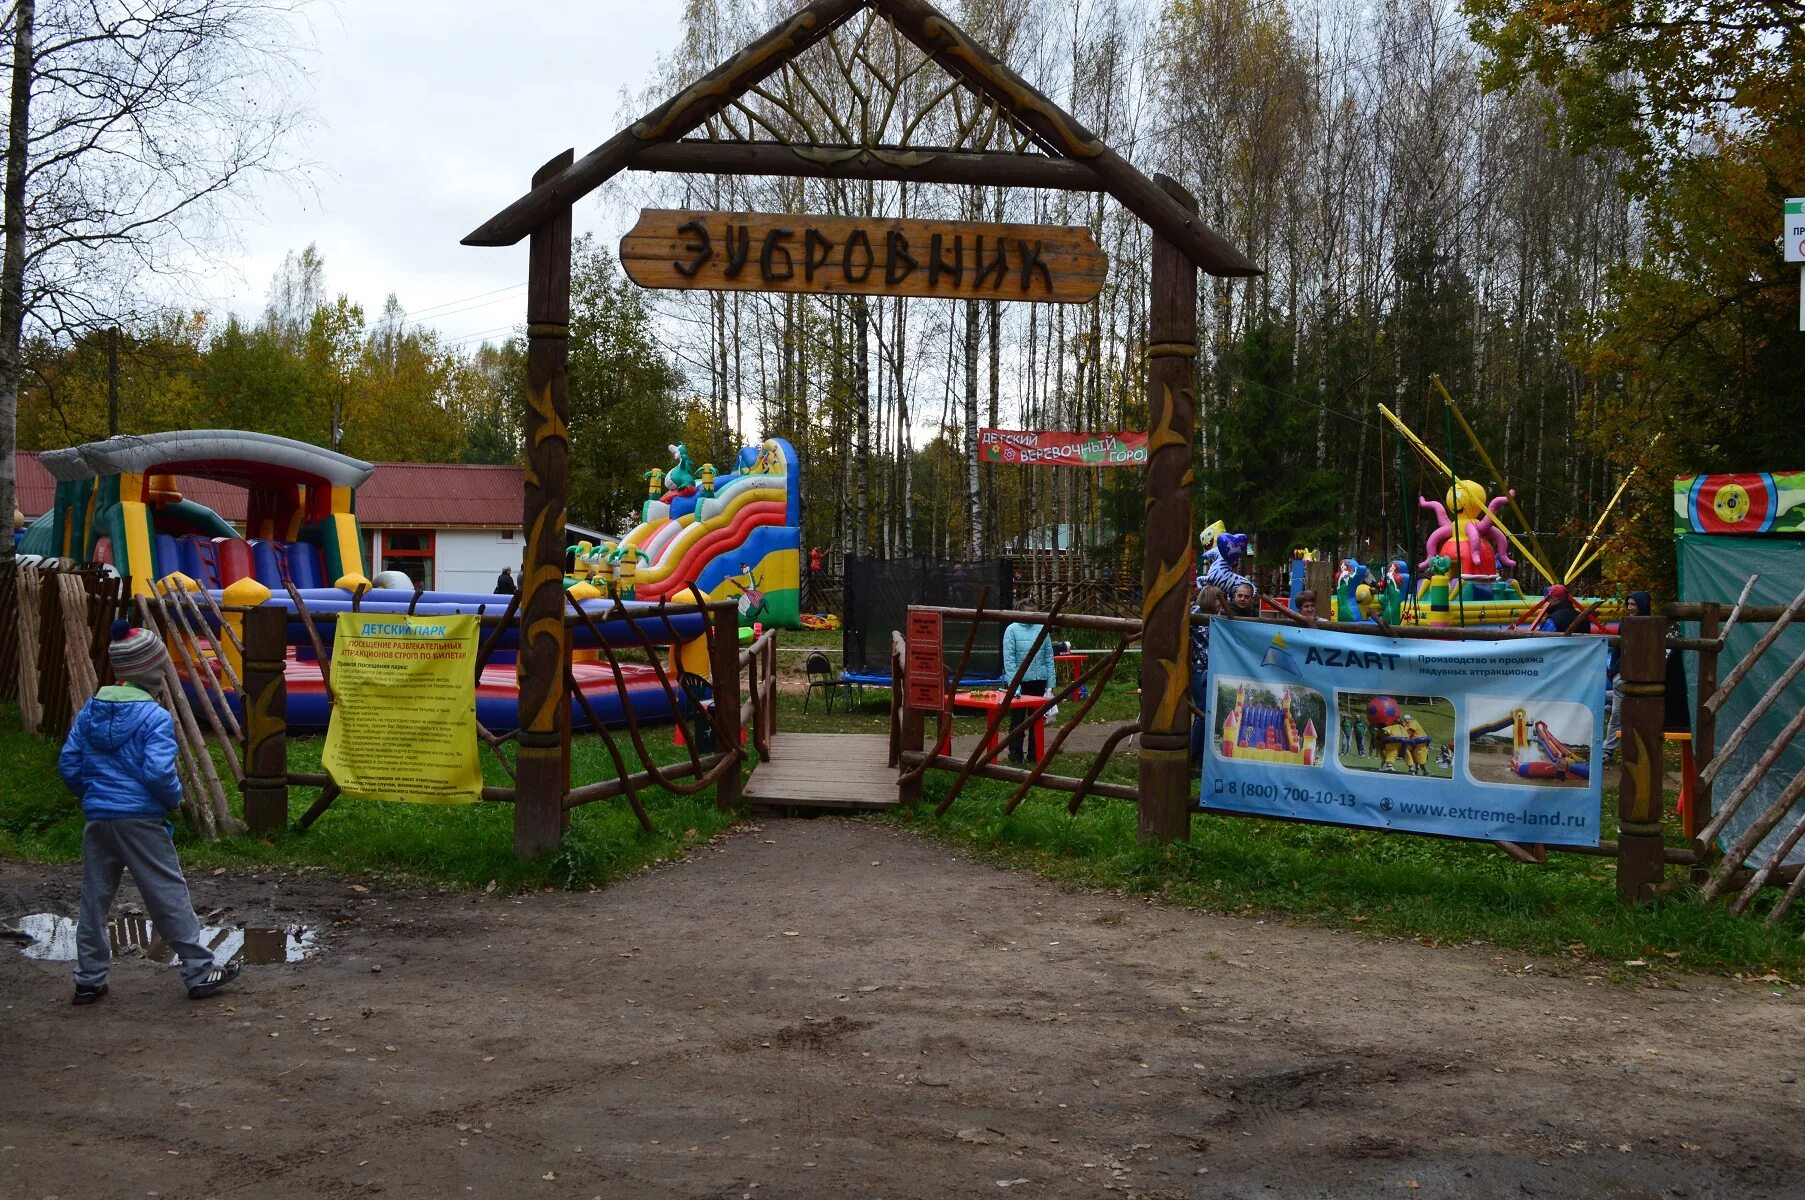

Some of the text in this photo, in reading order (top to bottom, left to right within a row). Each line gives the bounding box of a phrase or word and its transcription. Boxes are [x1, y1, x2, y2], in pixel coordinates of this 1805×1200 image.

[673, 220, 1054, 293] ЗУБРОВНИК
[981, 432, 1039, 446] ДЕТСКИЙ
[1020, 435, 1117, 462] ВЕРЕВОЧНЫЙ
[361, 622, 446, 636] ДЕТСКИЙ ПАРК
[348, 641, 392, 649] ПОСЕЩЕНИЕ
[341, 650, 393, 659] АТТРАКЦИОНОВ
[394, 652, 418, 660] СТРОГО
[1304, 646, 1400, 671] AZART
[1418, 655, 1487, 665] Производство
[1499, 656, 1544, 665] продажа
[1419, 667, 1539, 677] надувных аттракционов
[1228, 783, 1356, 808] 8 (800) 700-10-13
[1400, 803, 1586, 828] www.extreme-land.ru
